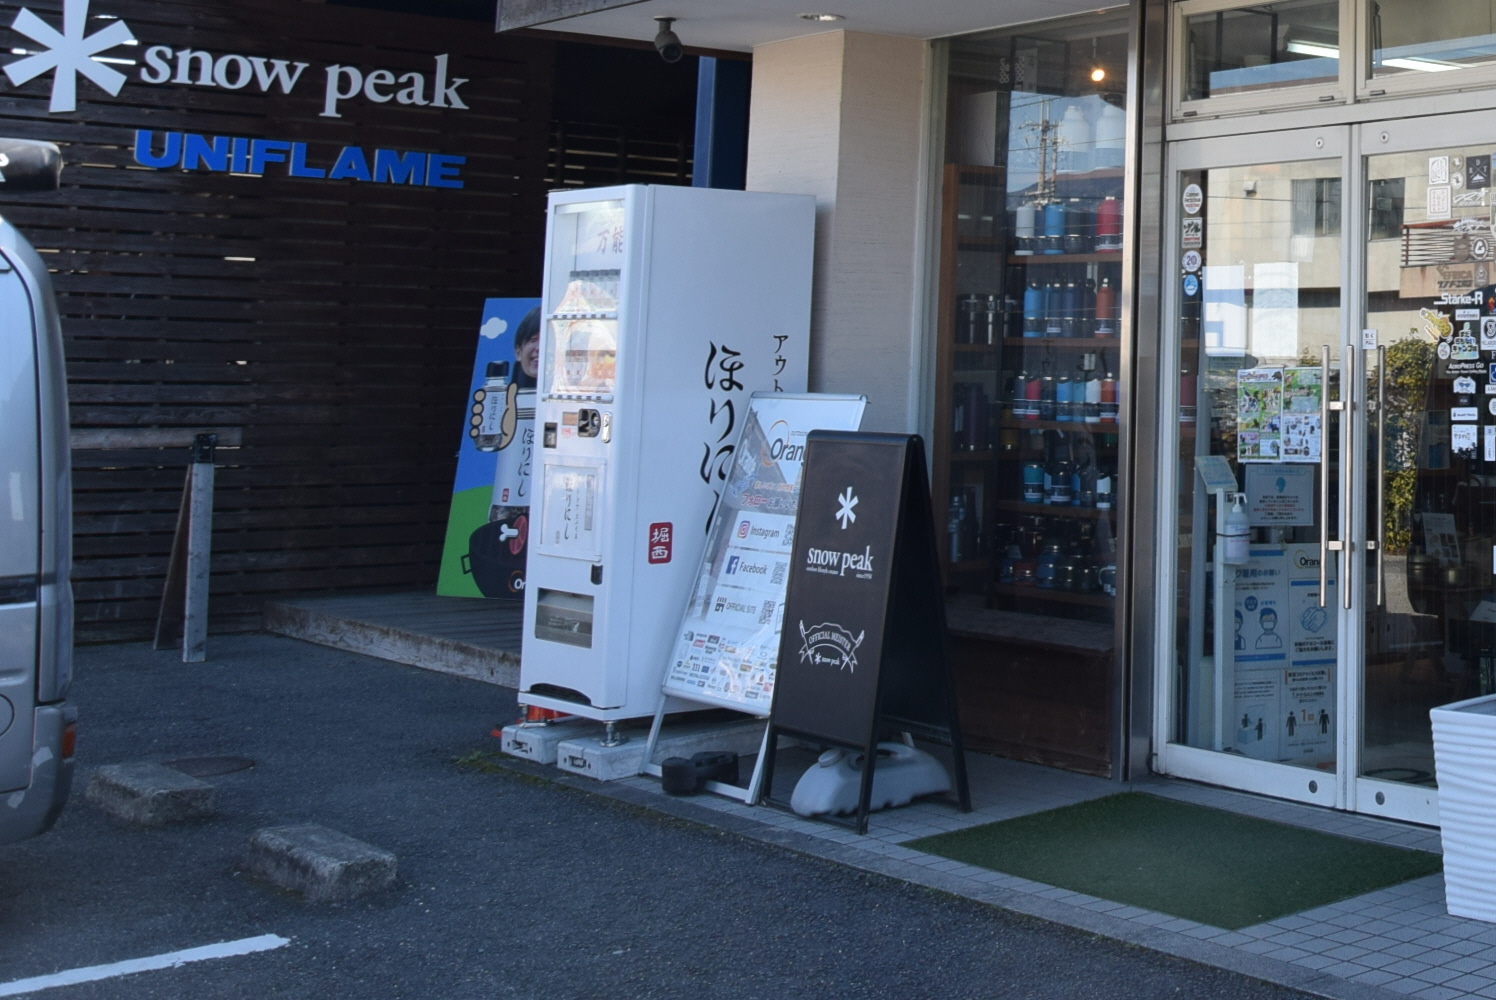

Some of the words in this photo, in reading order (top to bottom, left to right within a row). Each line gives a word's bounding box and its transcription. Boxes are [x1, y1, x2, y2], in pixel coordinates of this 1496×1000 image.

[141, 44, 309, 94] snow
[319, 54, 469, 117] peak
[134, 130, 467, 188] UNIFLAME
[770, 438, 804, 466] Oran
[650, 527, 670, 560] 堀西
[750, 526, 780, 540] Instagram
[740, 561, 768, 575] Facebook
[807, 547, 841, 566] snow
[840, 545, 874, 576] peak
[726, 603, 745, 613] OFFICIAL
[745, 605, 757, 614] SITE
[808, 630, 831, 644] OFFICIAL
[831, 631, 852, 652] MEISTER
